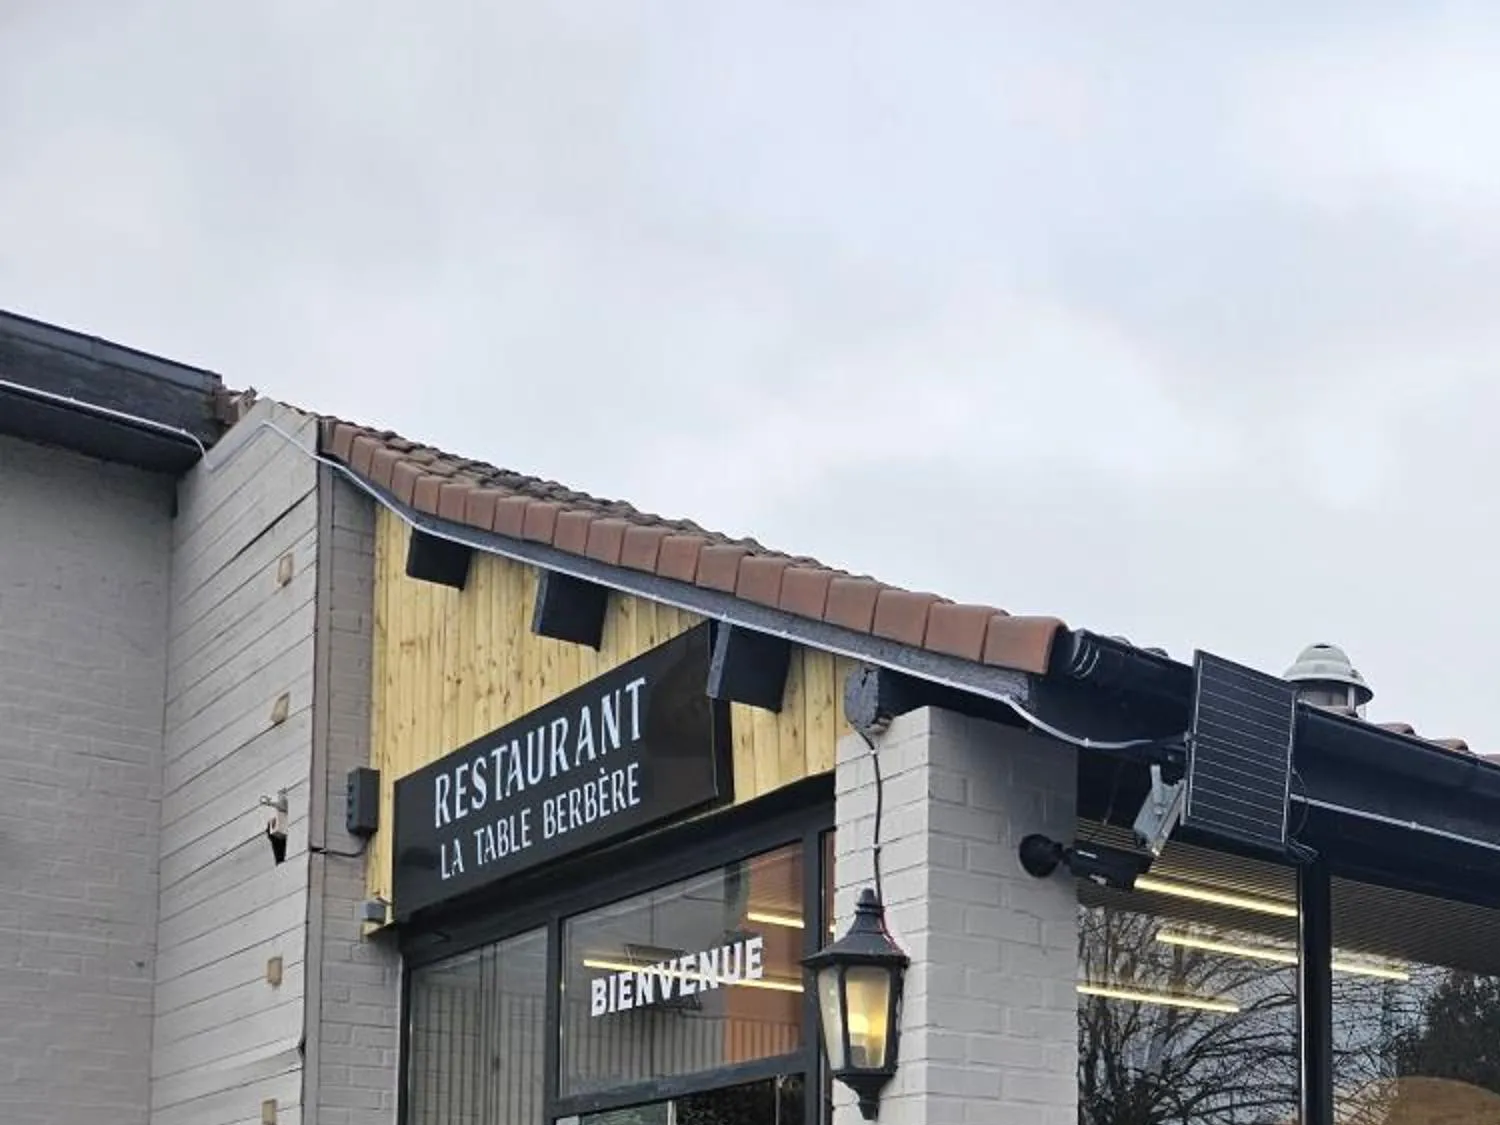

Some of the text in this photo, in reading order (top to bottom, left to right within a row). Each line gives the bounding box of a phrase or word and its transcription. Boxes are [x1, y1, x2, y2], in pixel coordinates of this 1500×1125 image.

[435, 677, 645, 829] RESTAURANT
[440, 762, 641, 881] LA TABLE BERBÈRE
[591, 936, 764, 1017] BIENVENUE
